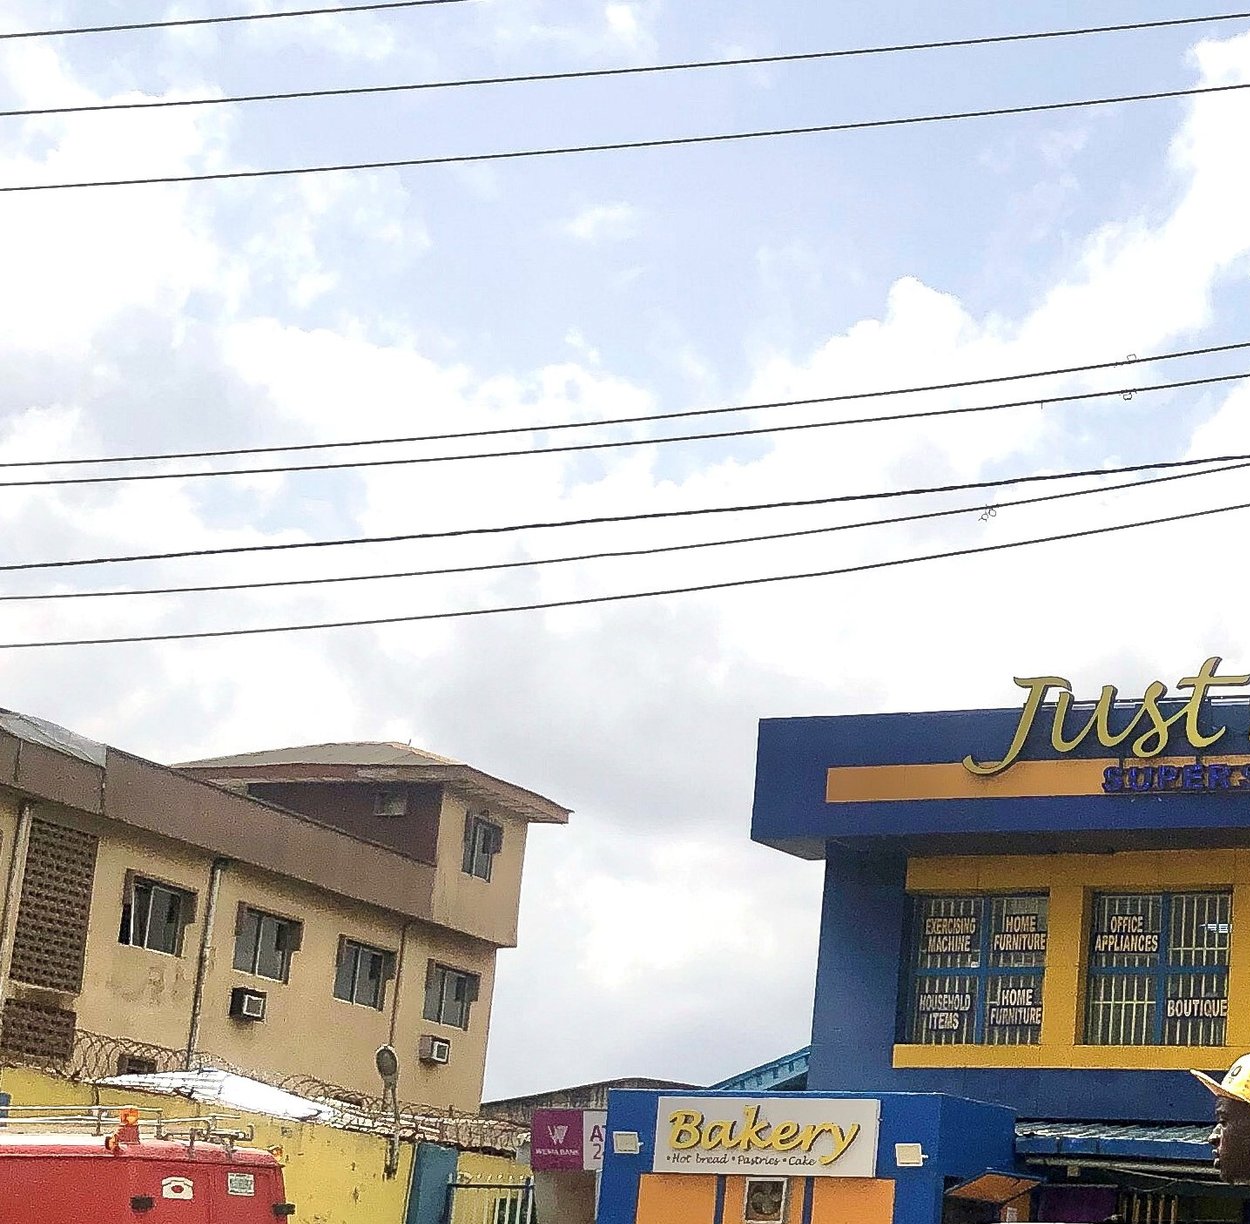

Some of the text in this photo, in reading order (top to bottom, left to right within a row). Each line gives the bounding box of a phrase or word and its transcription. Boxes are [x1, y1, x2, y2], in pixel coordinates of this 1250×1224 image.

[925, 917, 976, 935] EXERCISING
[1005, 915, 1036, 933] HOME
[1110, 915, 1143, 933] OFFICE
[927, 935, 971, 952] MACHINE
[993, 933, 1046, 950] FURNITURE
[1094, 934, 1158, 952] APPLIANCES
[919, 994, 971, 1011] HOUSEHOLD
[1001, 988, 1033, 1006] HOME
[990, 1007, 1041, 1025] FURNITURE
[1166, 999, 1228, 1018] BOUTIQUE
[928, 1012, 959, 1030] ITEMS
[668, 1104, 861, 1165] Bakery
[672, 1153, 816, 1166] Hot bread Pastries Cake
